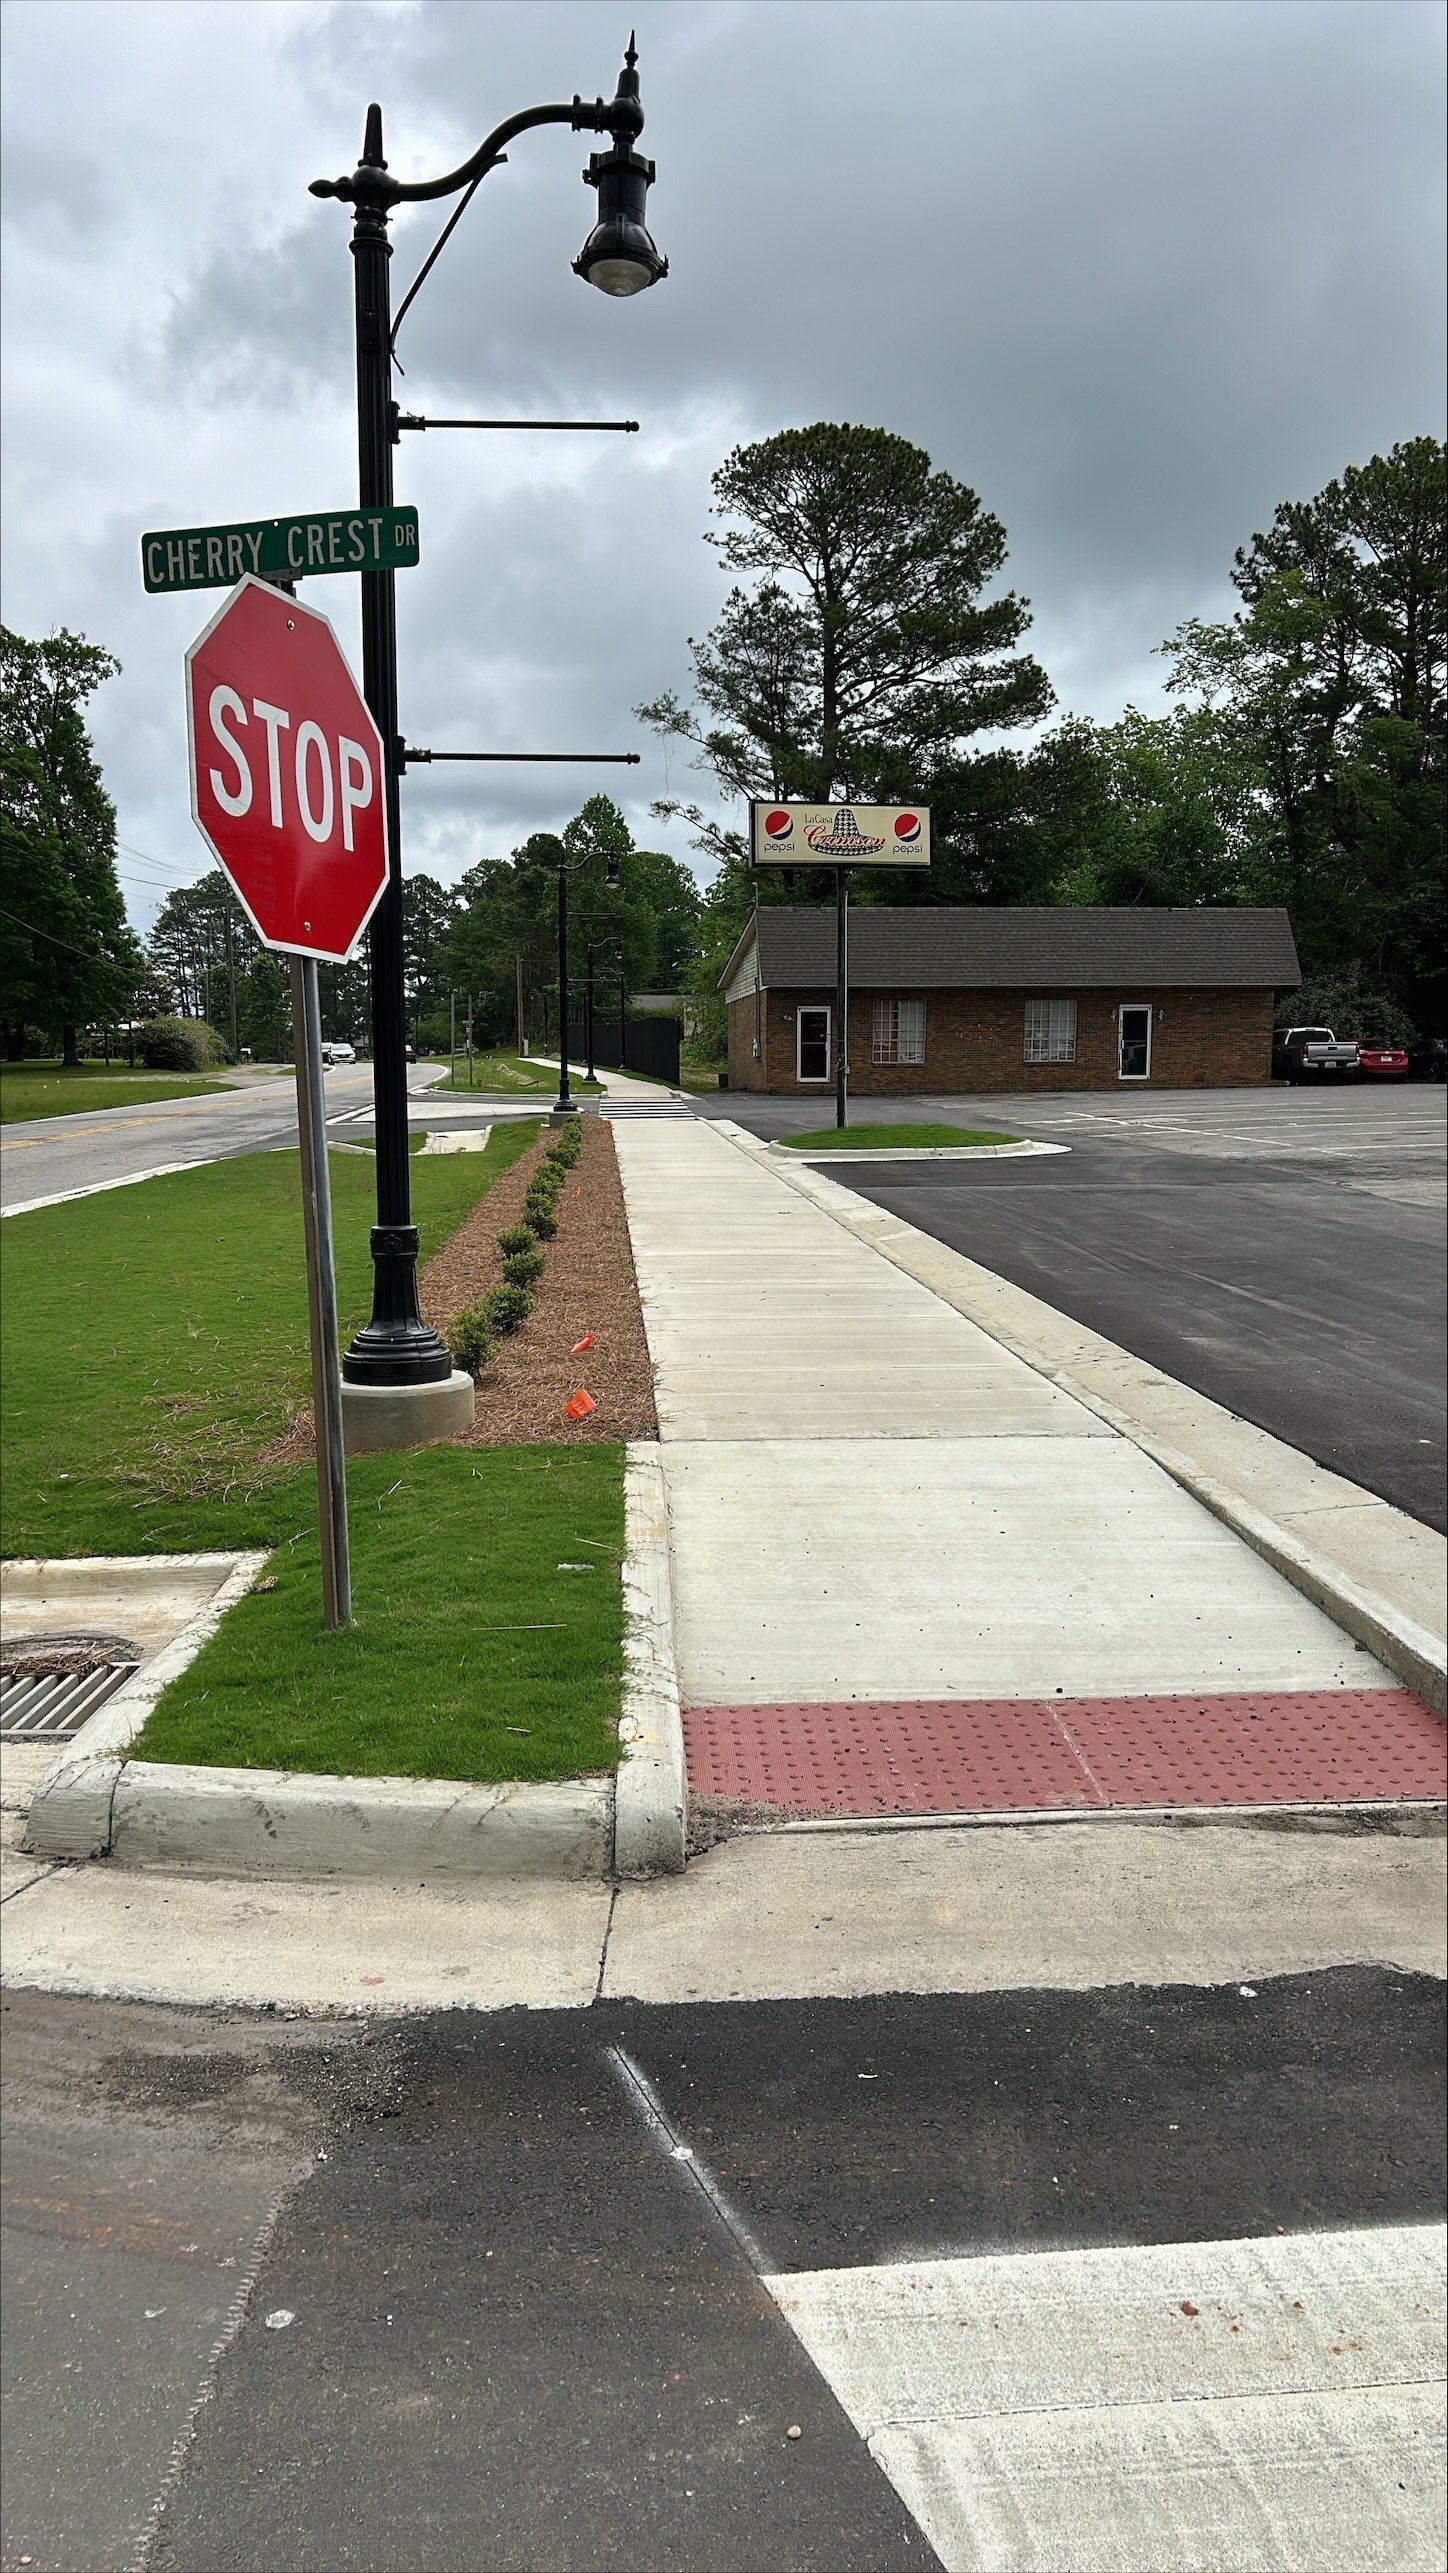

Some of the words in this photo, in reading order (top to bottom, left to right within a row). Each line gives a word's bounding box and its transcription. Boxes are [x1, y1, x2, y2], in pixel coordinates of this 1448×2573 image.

[147, 531, 264, 584] CHERRY
[287, 517, 384, 568] CREST
[395, 524, 416, 547] DR
[208, 684, 373, 852] STOP
[803, 824, 887, 847] Crimson
[763, 842, 795, 853] pepsi
[892, 844, 923, 855] pepsi
